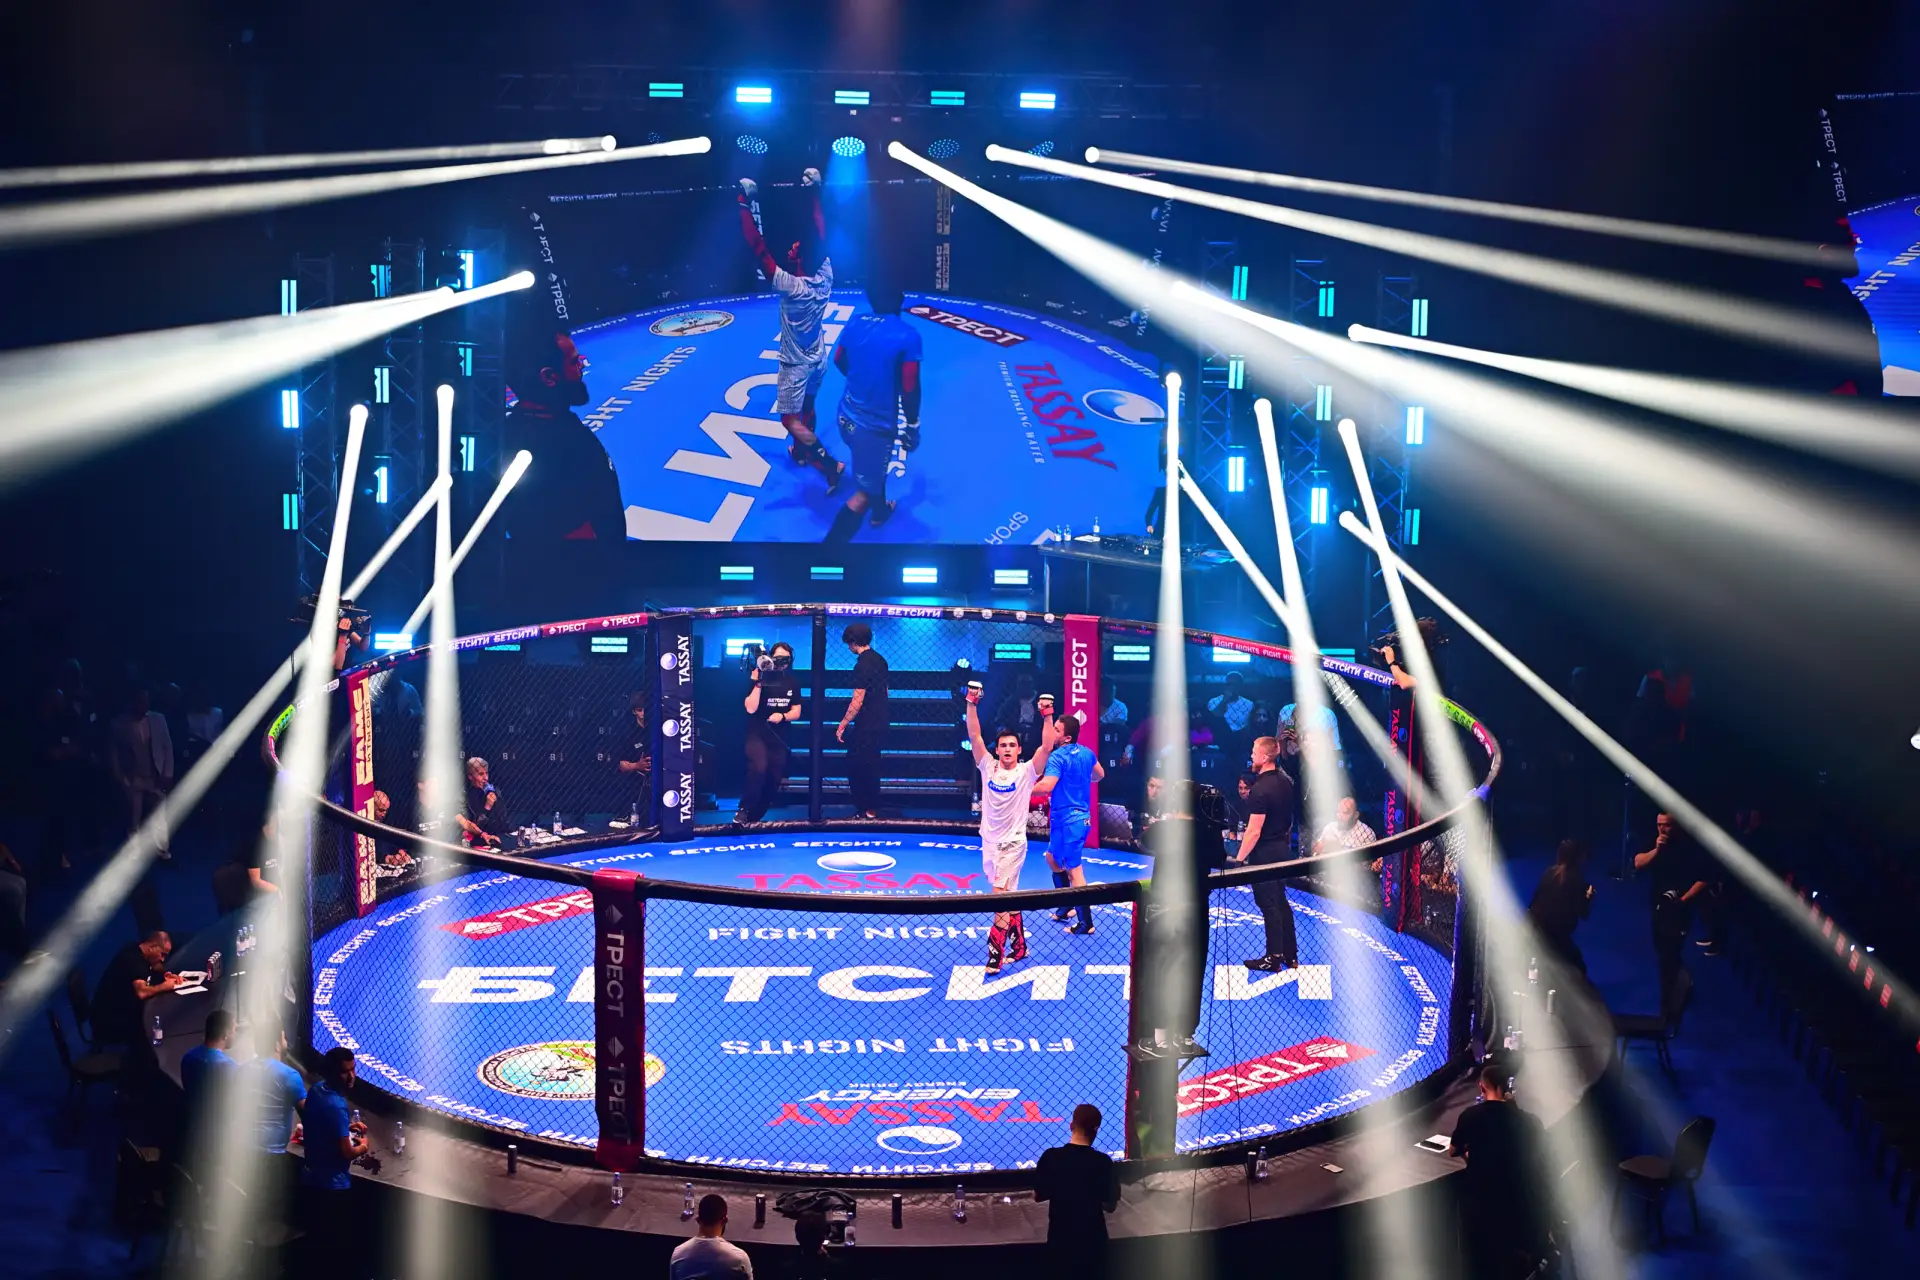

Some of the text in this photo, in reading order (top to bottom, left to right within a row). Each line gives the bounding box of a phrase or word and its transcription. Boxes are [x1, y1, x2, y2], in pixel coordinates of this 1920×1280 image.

[1821, 118, 1837, 154] ТРЕСТ
[1832, 170, 1847, 203] ТРЕСТ
[550, 282, 569, 320] ТРЕСТ
[1852, 270, 1896, 301] GHT
[571, 316, 628, 335] БЕТСИТИ
[929, 311, 1026, 344] ТРЕСТ
[1097, 345, 1160, 379] БЕТСИТИ
[582, 345, 697, 433] GHT NIGHTS
[1014, 361, 1118, 472] TASSAY
[1025, 431, 1046, 464] WATER
[557, 615, 641, 634] ТРЕСТ ТРЕСТ
[827, 605, 942, 618] БЕТСИТИ БЕТСИТИ
[448, 627, 539, 651] БЕТСИТИ БЕТСИТИ
[1214, 639, 1234, 650] FIGHT
[1236, 643, 1260, 655] NIGHTS
[1262, 649, 1282, 660] FIGHT
[677, 634, 691, 686] TASSAY
[1071, 637, 1088, 707] ТРЕСТ
[1323, 658, 1362, 677] БЕТСИТИ
[680, 701, 692, 753] TASSAY
[679, 772, 692, 824] TASSAY
[1386, 789, 1396, 838] TASSAY
[669, 842, 776, 856] БЕТСИТИ
[791, 840, 902, 849] БЕТСИТИ
[737, 873, 982, 890] TASSAY
[327, 928, 378, 964] БЕТСИТИ
[377, 894, 450, 927] БЕТСИТИ
[456, 875, 522, 894] БЕТСИ
[496, 889, 595, 923] ТРЕ
[708, 925, 1033, 941] FIGHT NIGH
[605, 931, 625, 1018] ТРЕСТ
[1342, 927, 1408, 962] БЕТСИТИ
[1401, 965, 1439, 1003] БЕТСИТИ
[720, 1036, 1076, 1056] FIGHT NIGHTS
[354, 1053, 426, 1092] БЕТСИТИ
[1371, 1049, 1426, 1088] БЕТСИТИ
[605, 1062, 632, 1145] ТРЕСТ
[803, 1088, 1022, 1101] ENERGY
[1286, 1088, 1373, 1124] БЕТСИТИ
[426, 1094, 529, 1130] БЕТСИТИ
[766, 1101, 1064, 1126] TASSAY
[688, 1155, 830, 1172] БЕТСИТИ
[851, 1162, 994, 1174] БЕТСИТИ
